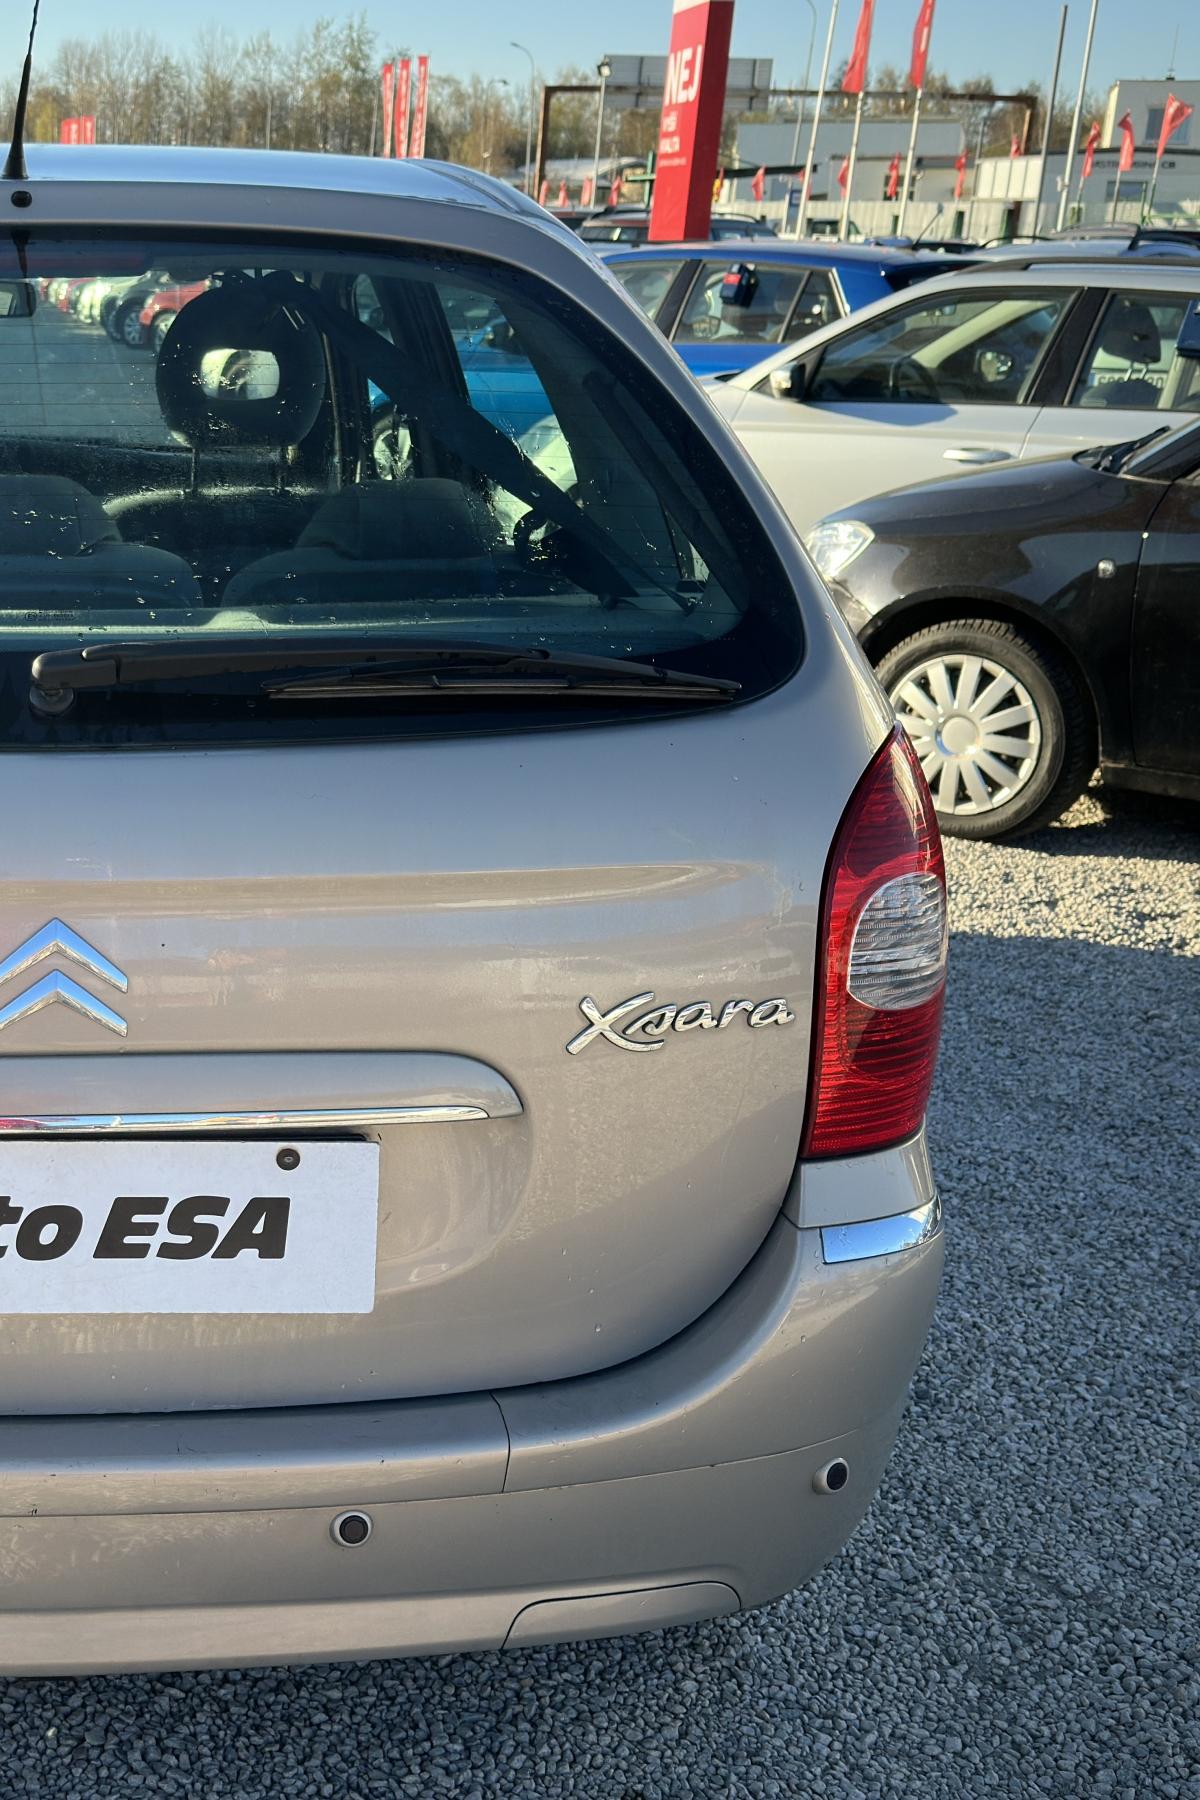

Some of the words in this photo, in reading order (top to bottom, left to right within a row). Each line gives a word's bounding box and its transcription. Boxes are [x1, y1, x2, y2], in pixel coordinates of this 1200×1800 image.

[664, 44, 702, 106] NEJ
[566, 991, 795, 1055] Xsara
[92, 1195, 291, 1260] ESA
